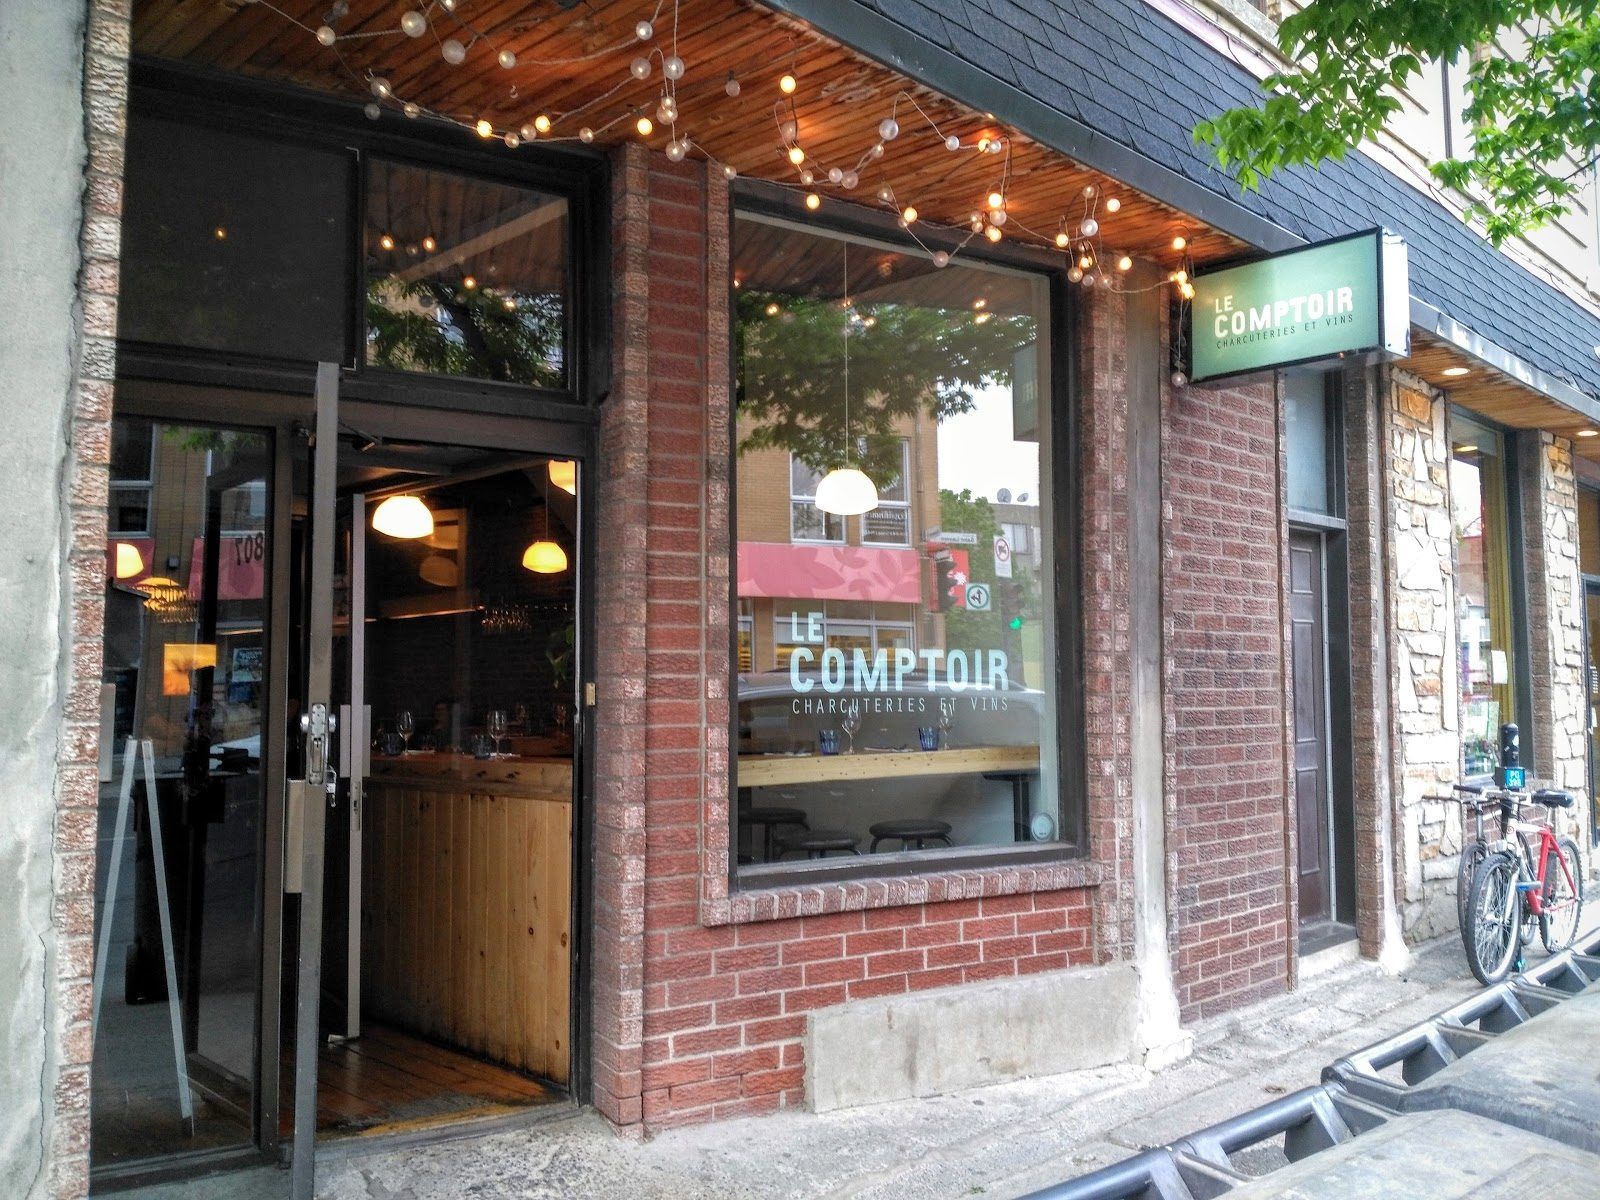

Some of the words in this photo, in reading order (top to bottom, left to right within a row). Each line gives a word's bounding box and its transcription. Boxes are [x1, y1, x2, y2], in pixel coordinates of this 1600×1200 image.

[1214, 286, 1354, 338] COMPTOIR
[1215, 295, 1233, 313] LE
[1216, 326, 1296, 349] CHARCUTERIES
[1304, 322, 1317, 332] ET
[1326, 314, 1354, 327] VINS
[791, 612, 824, 642] LE
[789, 647, 1009, 693] COMPTOIR
[792, 698, 926, 714] CHARCUTERIES
[940, 697, 956, 713] ET
[971, 697, 1009, 712] VINS
